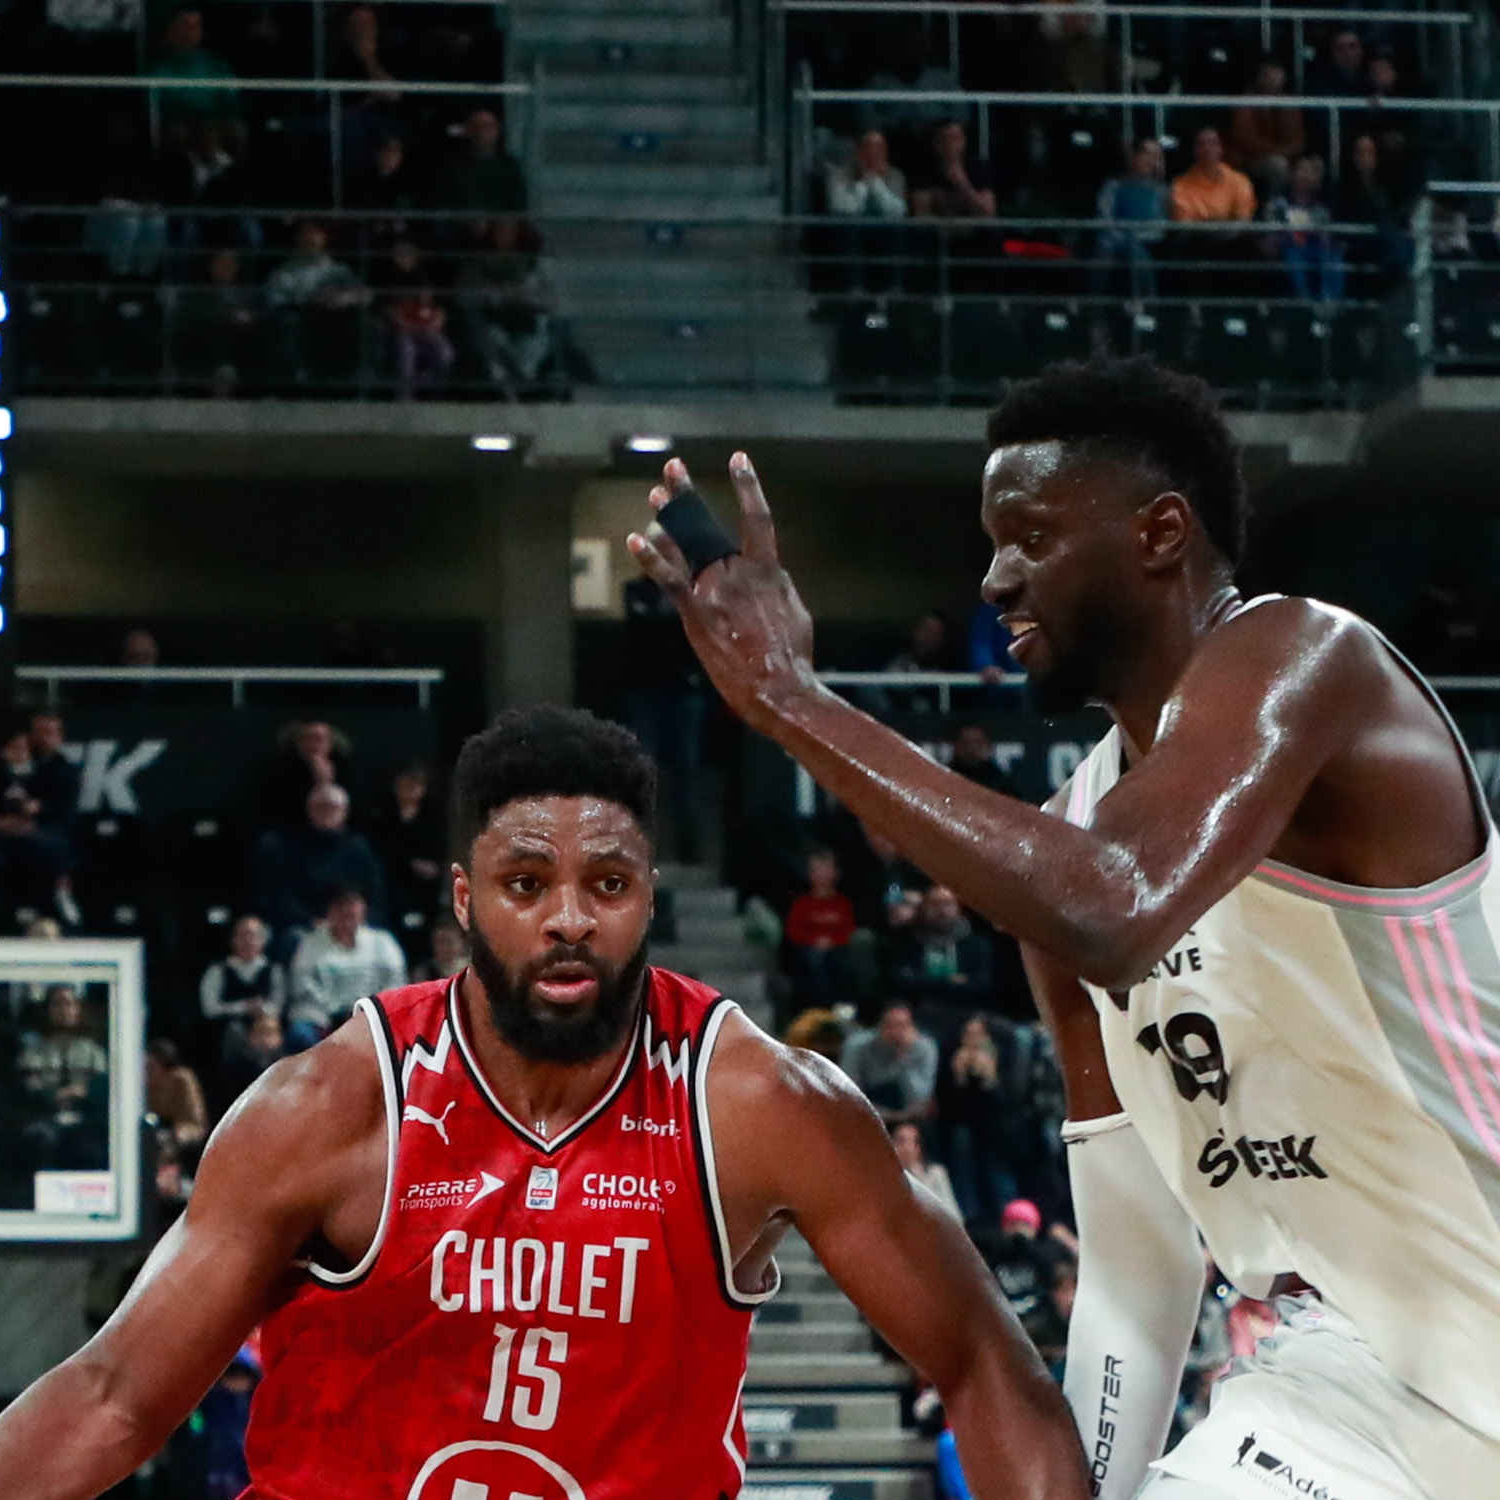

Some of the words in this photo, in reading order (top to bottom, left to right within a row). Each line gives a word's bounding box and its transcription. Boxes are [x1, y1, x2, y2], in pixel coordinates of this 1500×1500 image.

[1136, 1011, 1231, 1106] 19
[399, 1195, 464, 1211] Transports
[431, 1229, 650, 1324] CHOLET
[483, 1322, 569, 1431] 15
